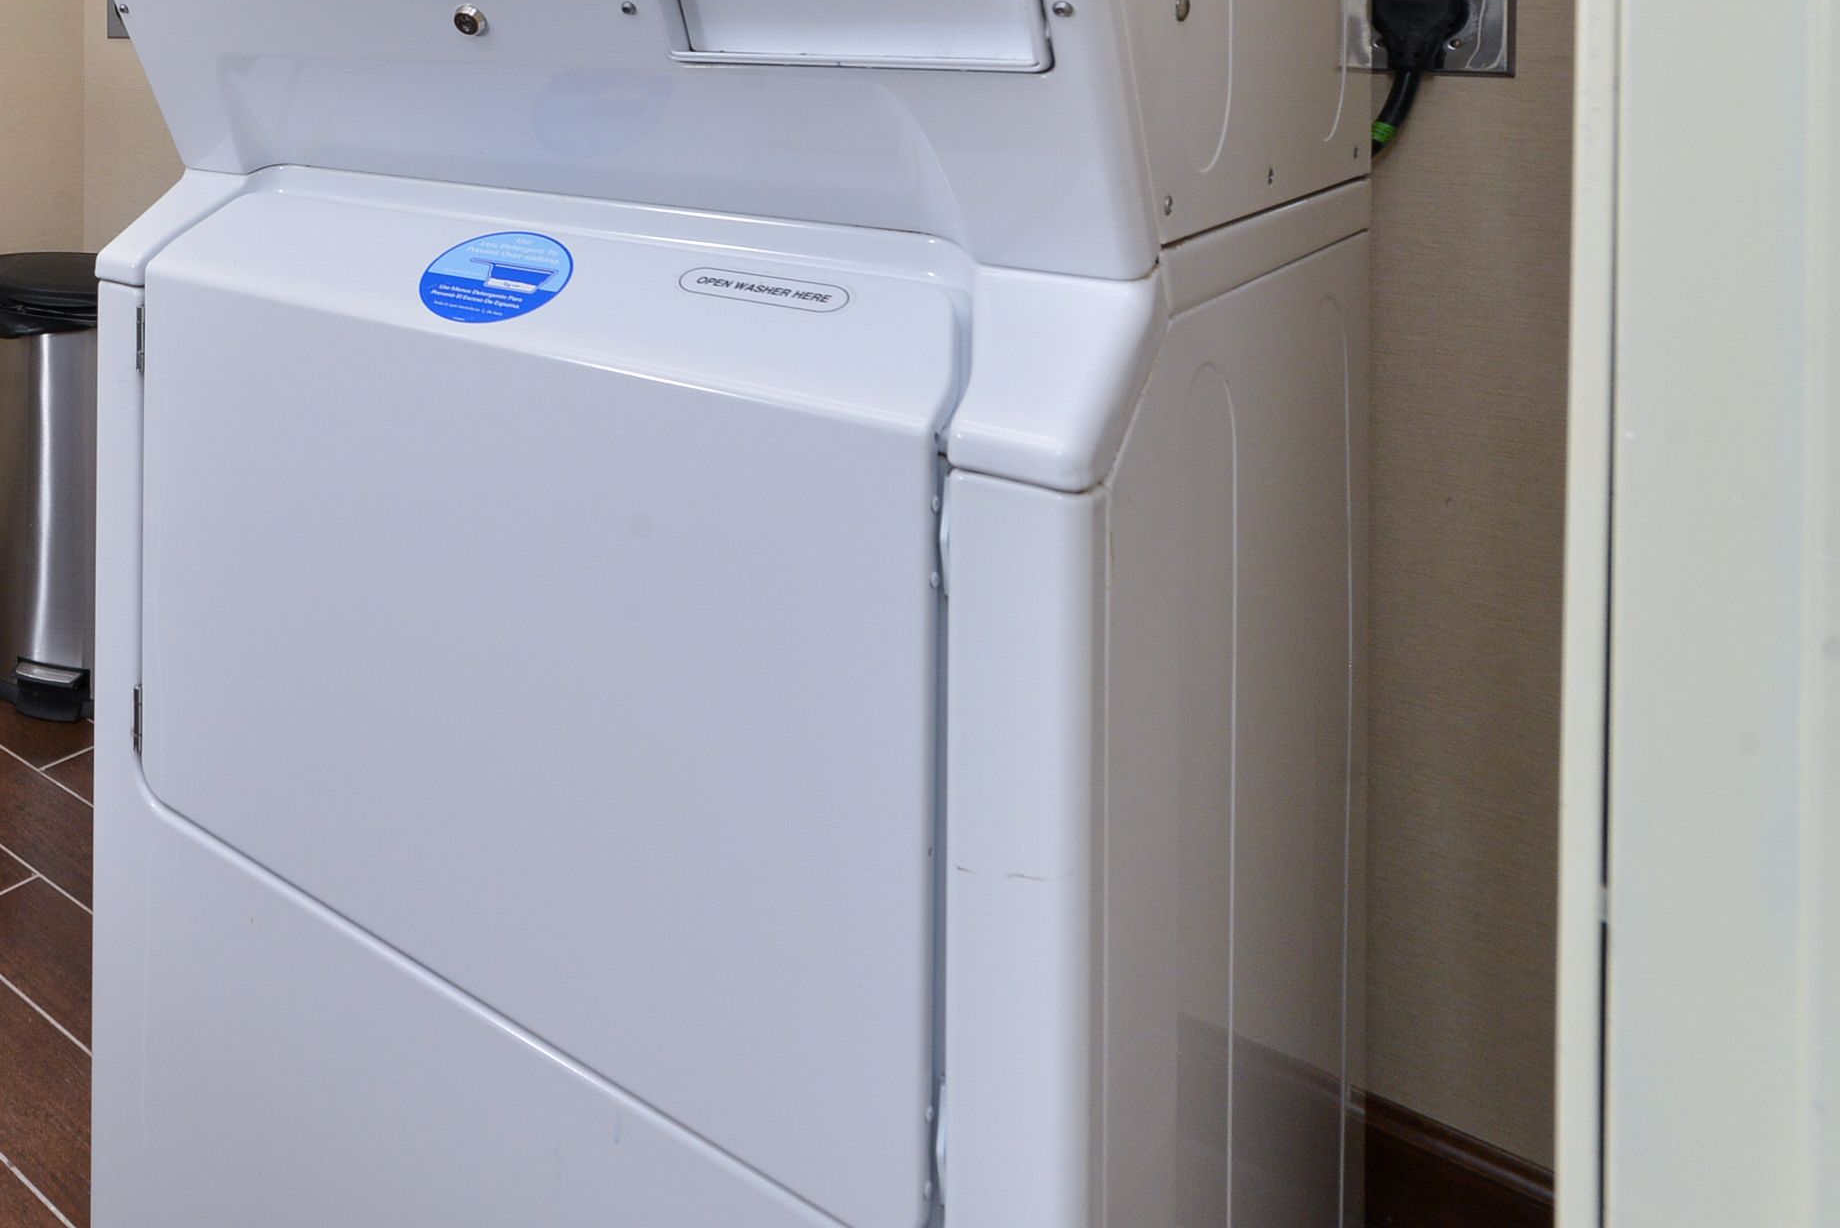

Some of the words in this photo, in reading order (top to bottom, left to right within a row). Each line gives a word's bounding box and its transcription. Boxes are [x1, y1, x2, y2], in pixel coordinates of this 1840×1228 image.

[696, 276, 733, 289] OPEN
[734, 281, 792, 298] WASHER
[792, 290, 832, 303] HERE
